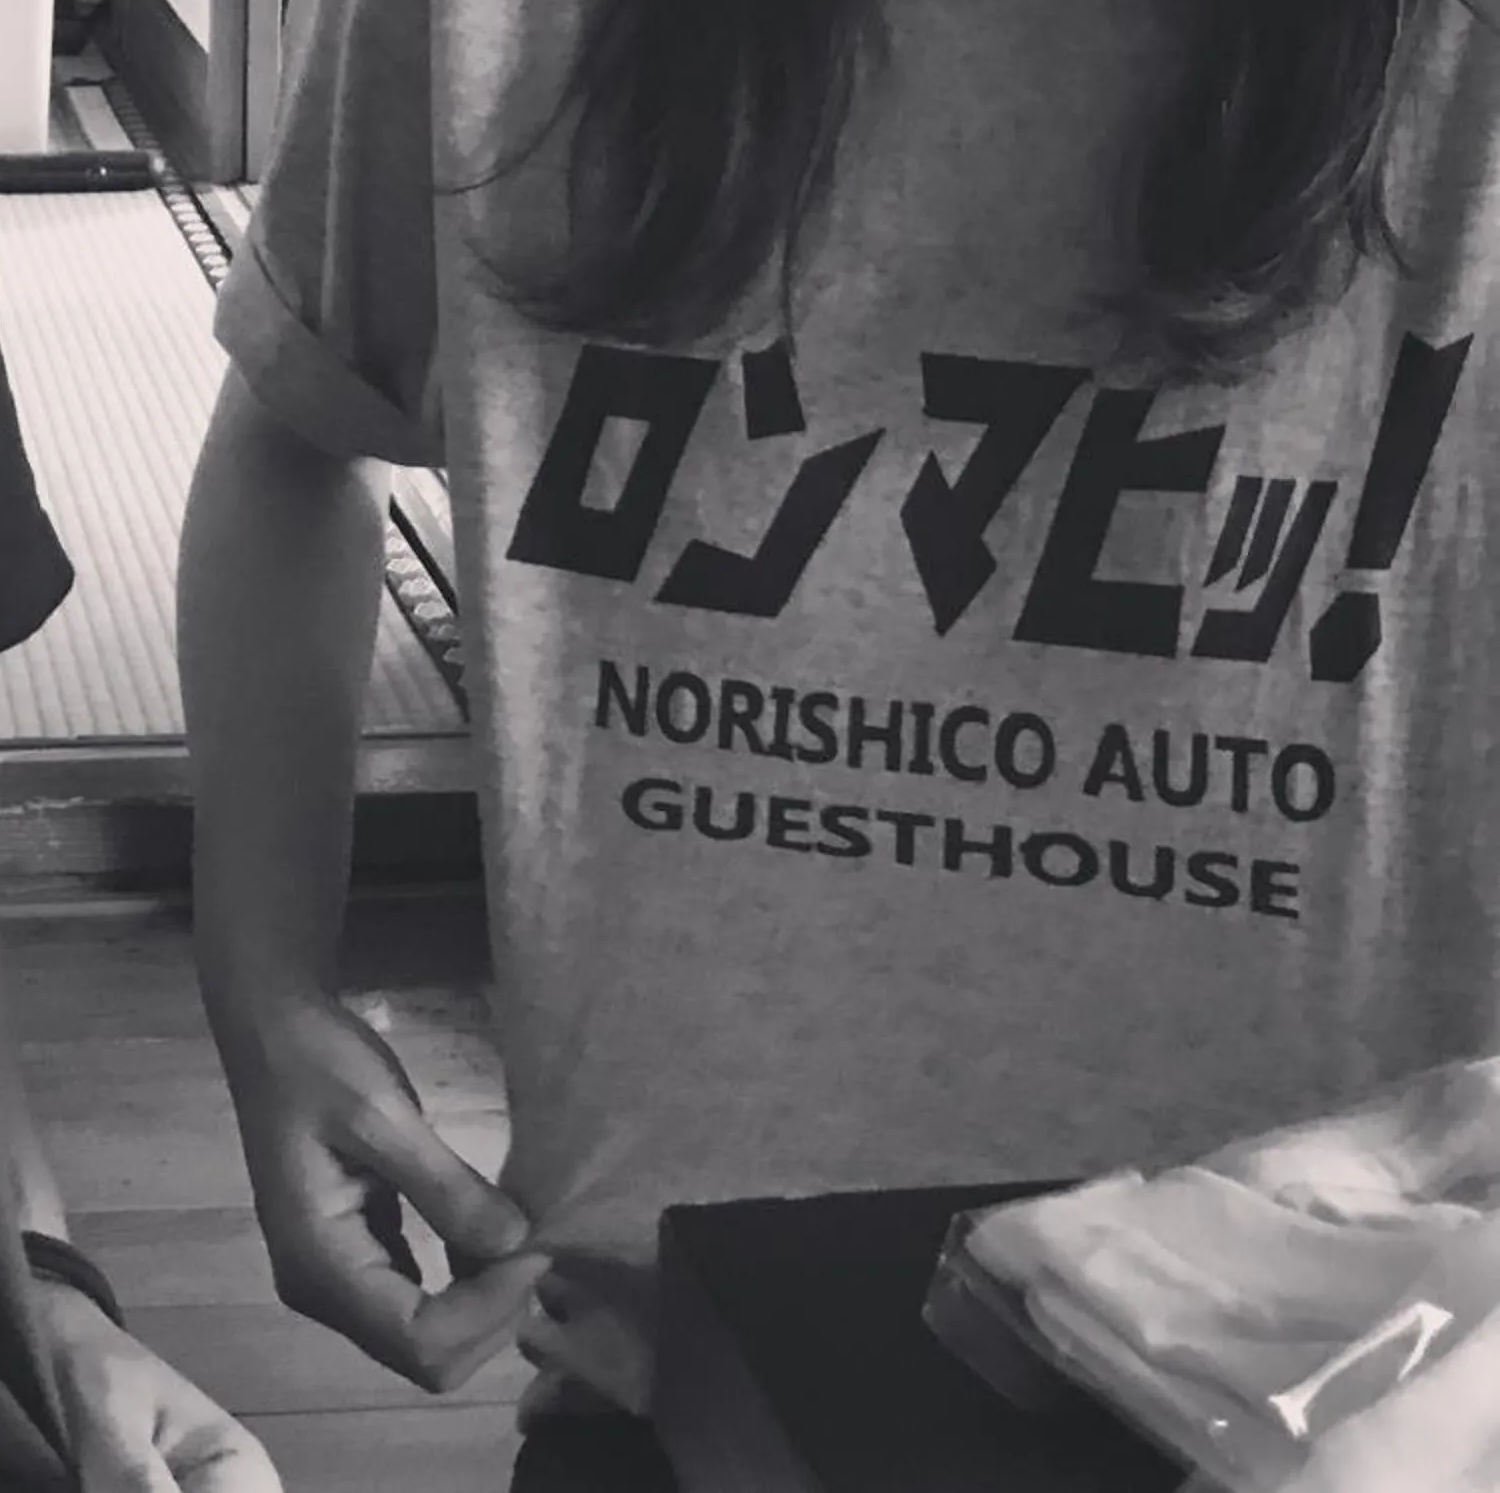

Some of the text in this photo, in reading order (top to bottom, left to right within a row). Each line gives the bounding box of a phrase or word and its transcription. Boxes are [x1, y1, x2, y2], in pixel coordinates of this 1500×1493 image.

[594, 658, 1338, 824] NORISHICO AUTO
[620, 775, 1302, 920] GUESTHOUSE
